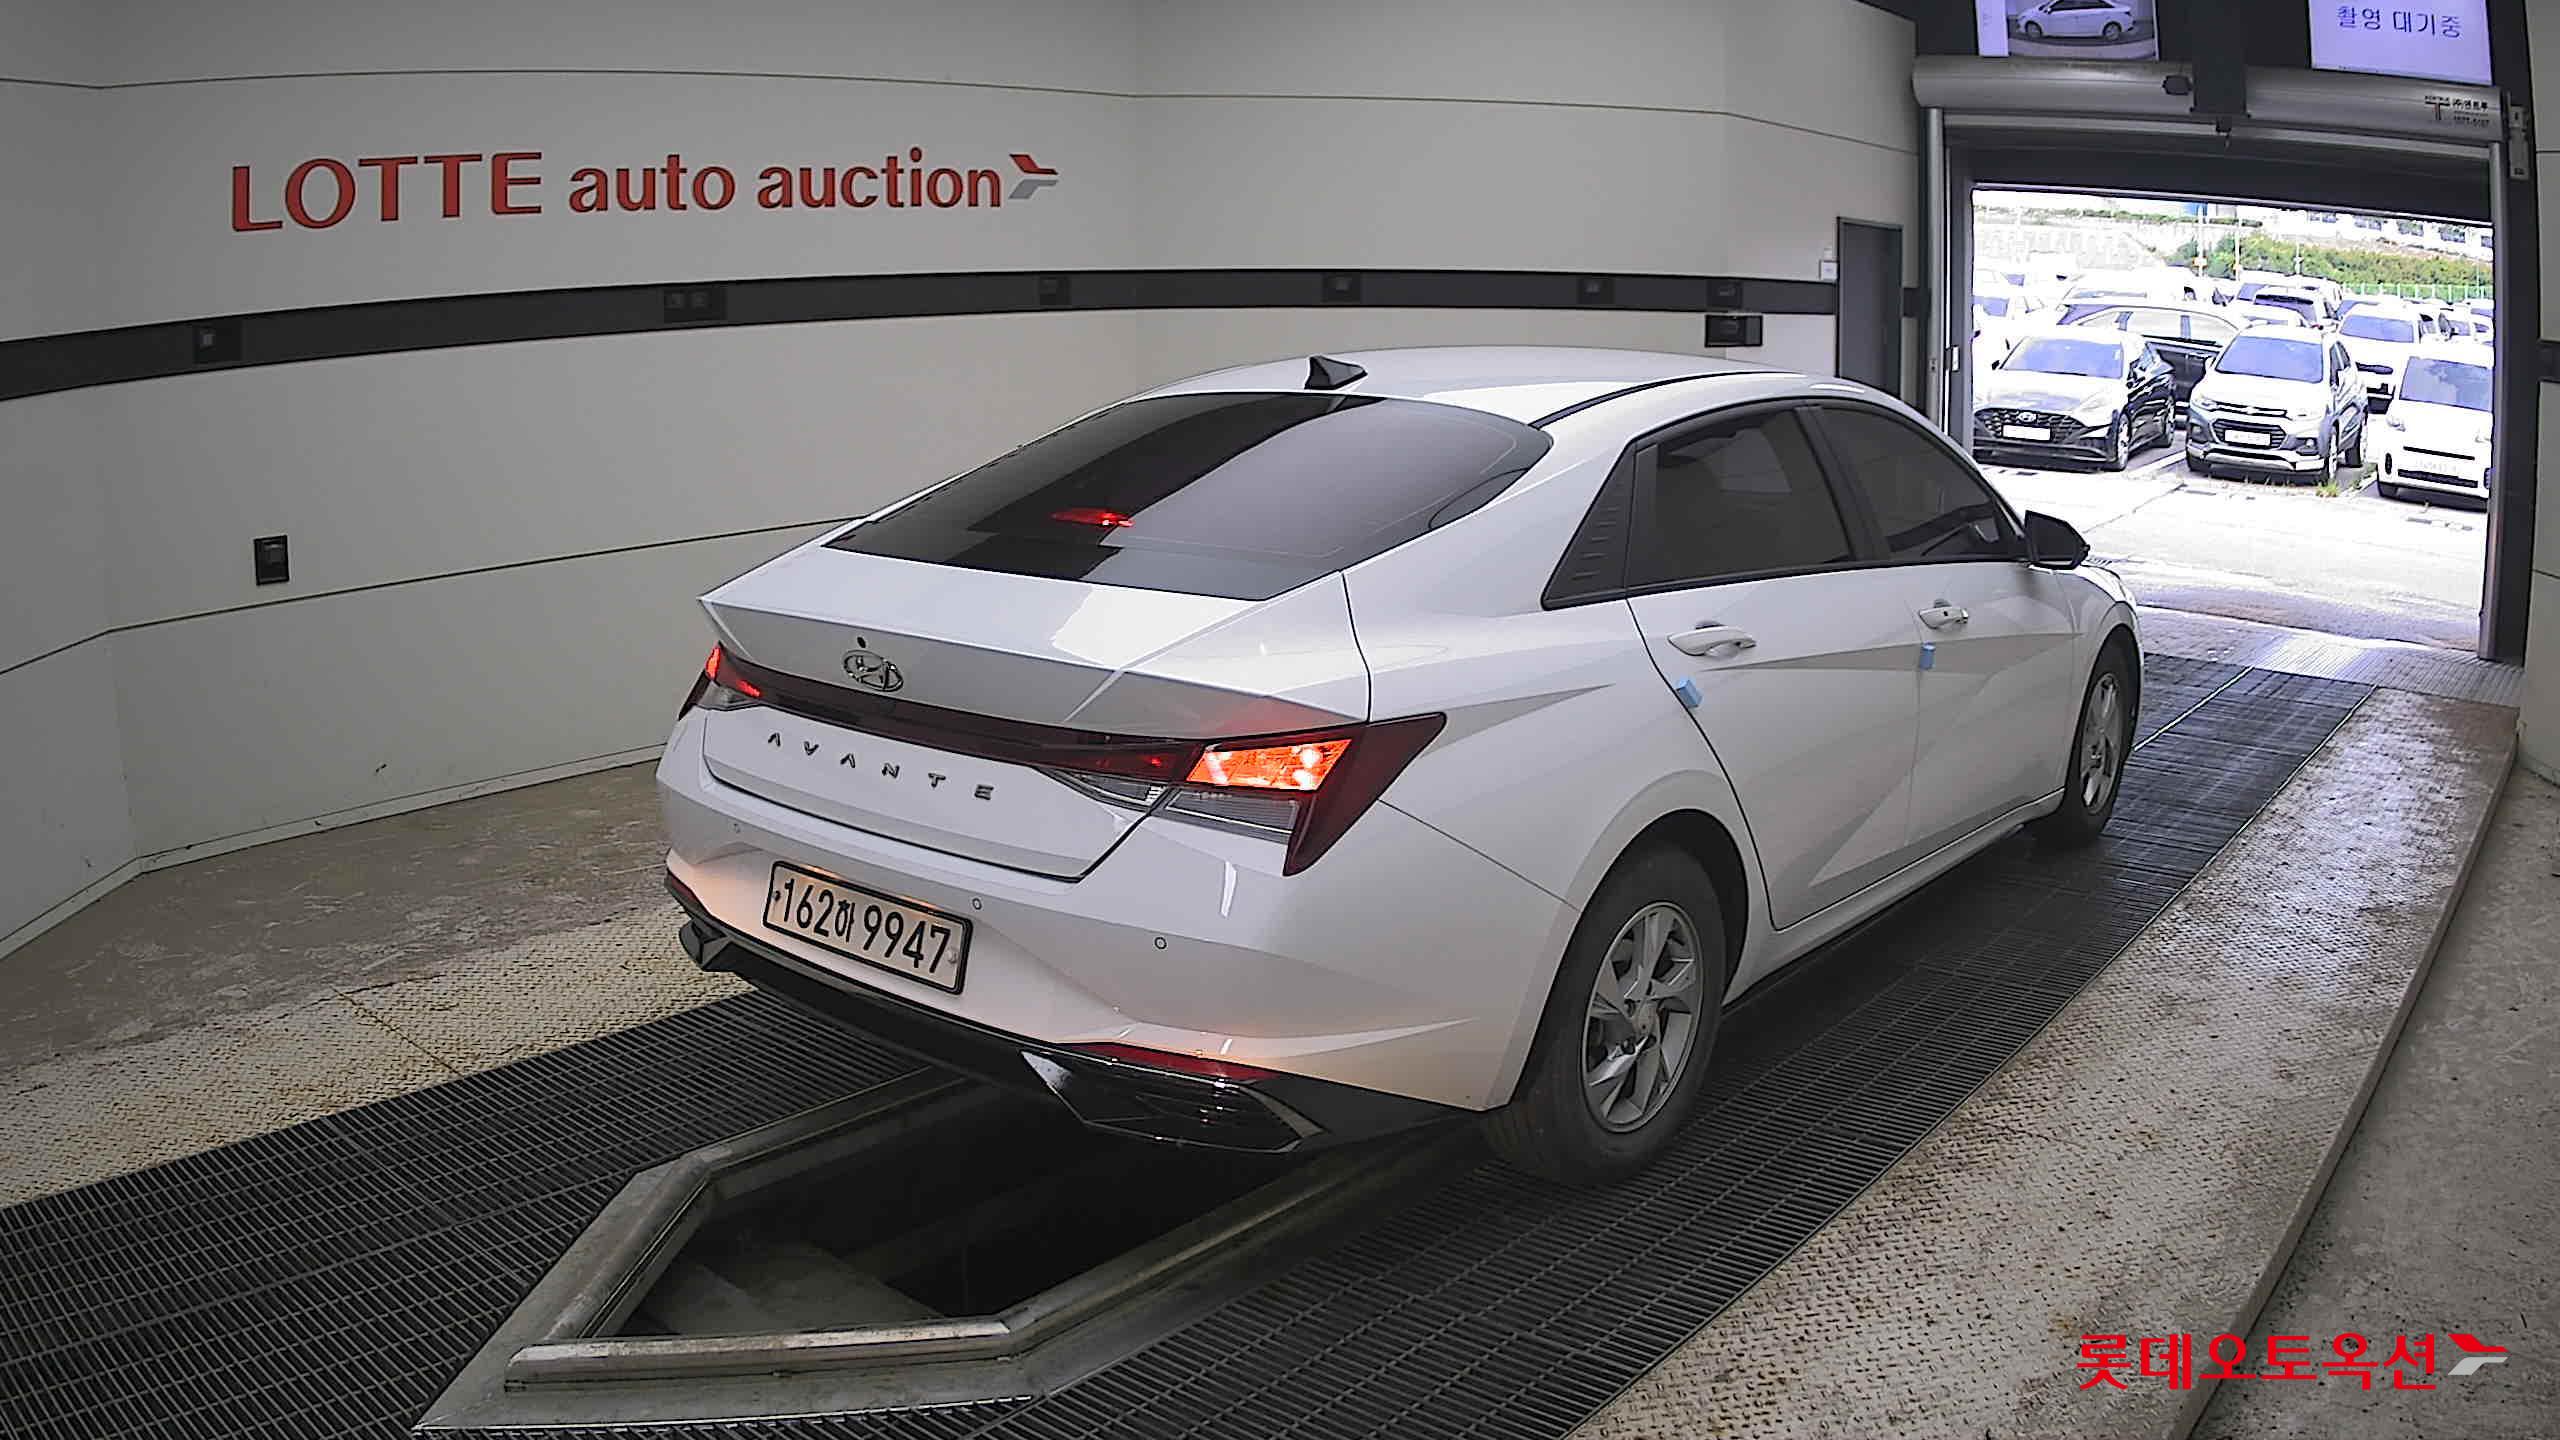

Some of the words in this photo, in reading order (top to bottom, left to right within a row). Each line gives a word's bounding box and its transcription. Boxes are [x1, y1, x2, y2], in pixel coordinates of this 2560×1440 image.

[2338, 7, 2381, 30] 촬영
[2393, 12, 2461, 38] 대기중
[232, 152, 542, 232] LOTTE
[569, 154, 735, 213] auto
[756, 147, 1001, 209] auction
[767, 732, 994, 800] AVANTE
